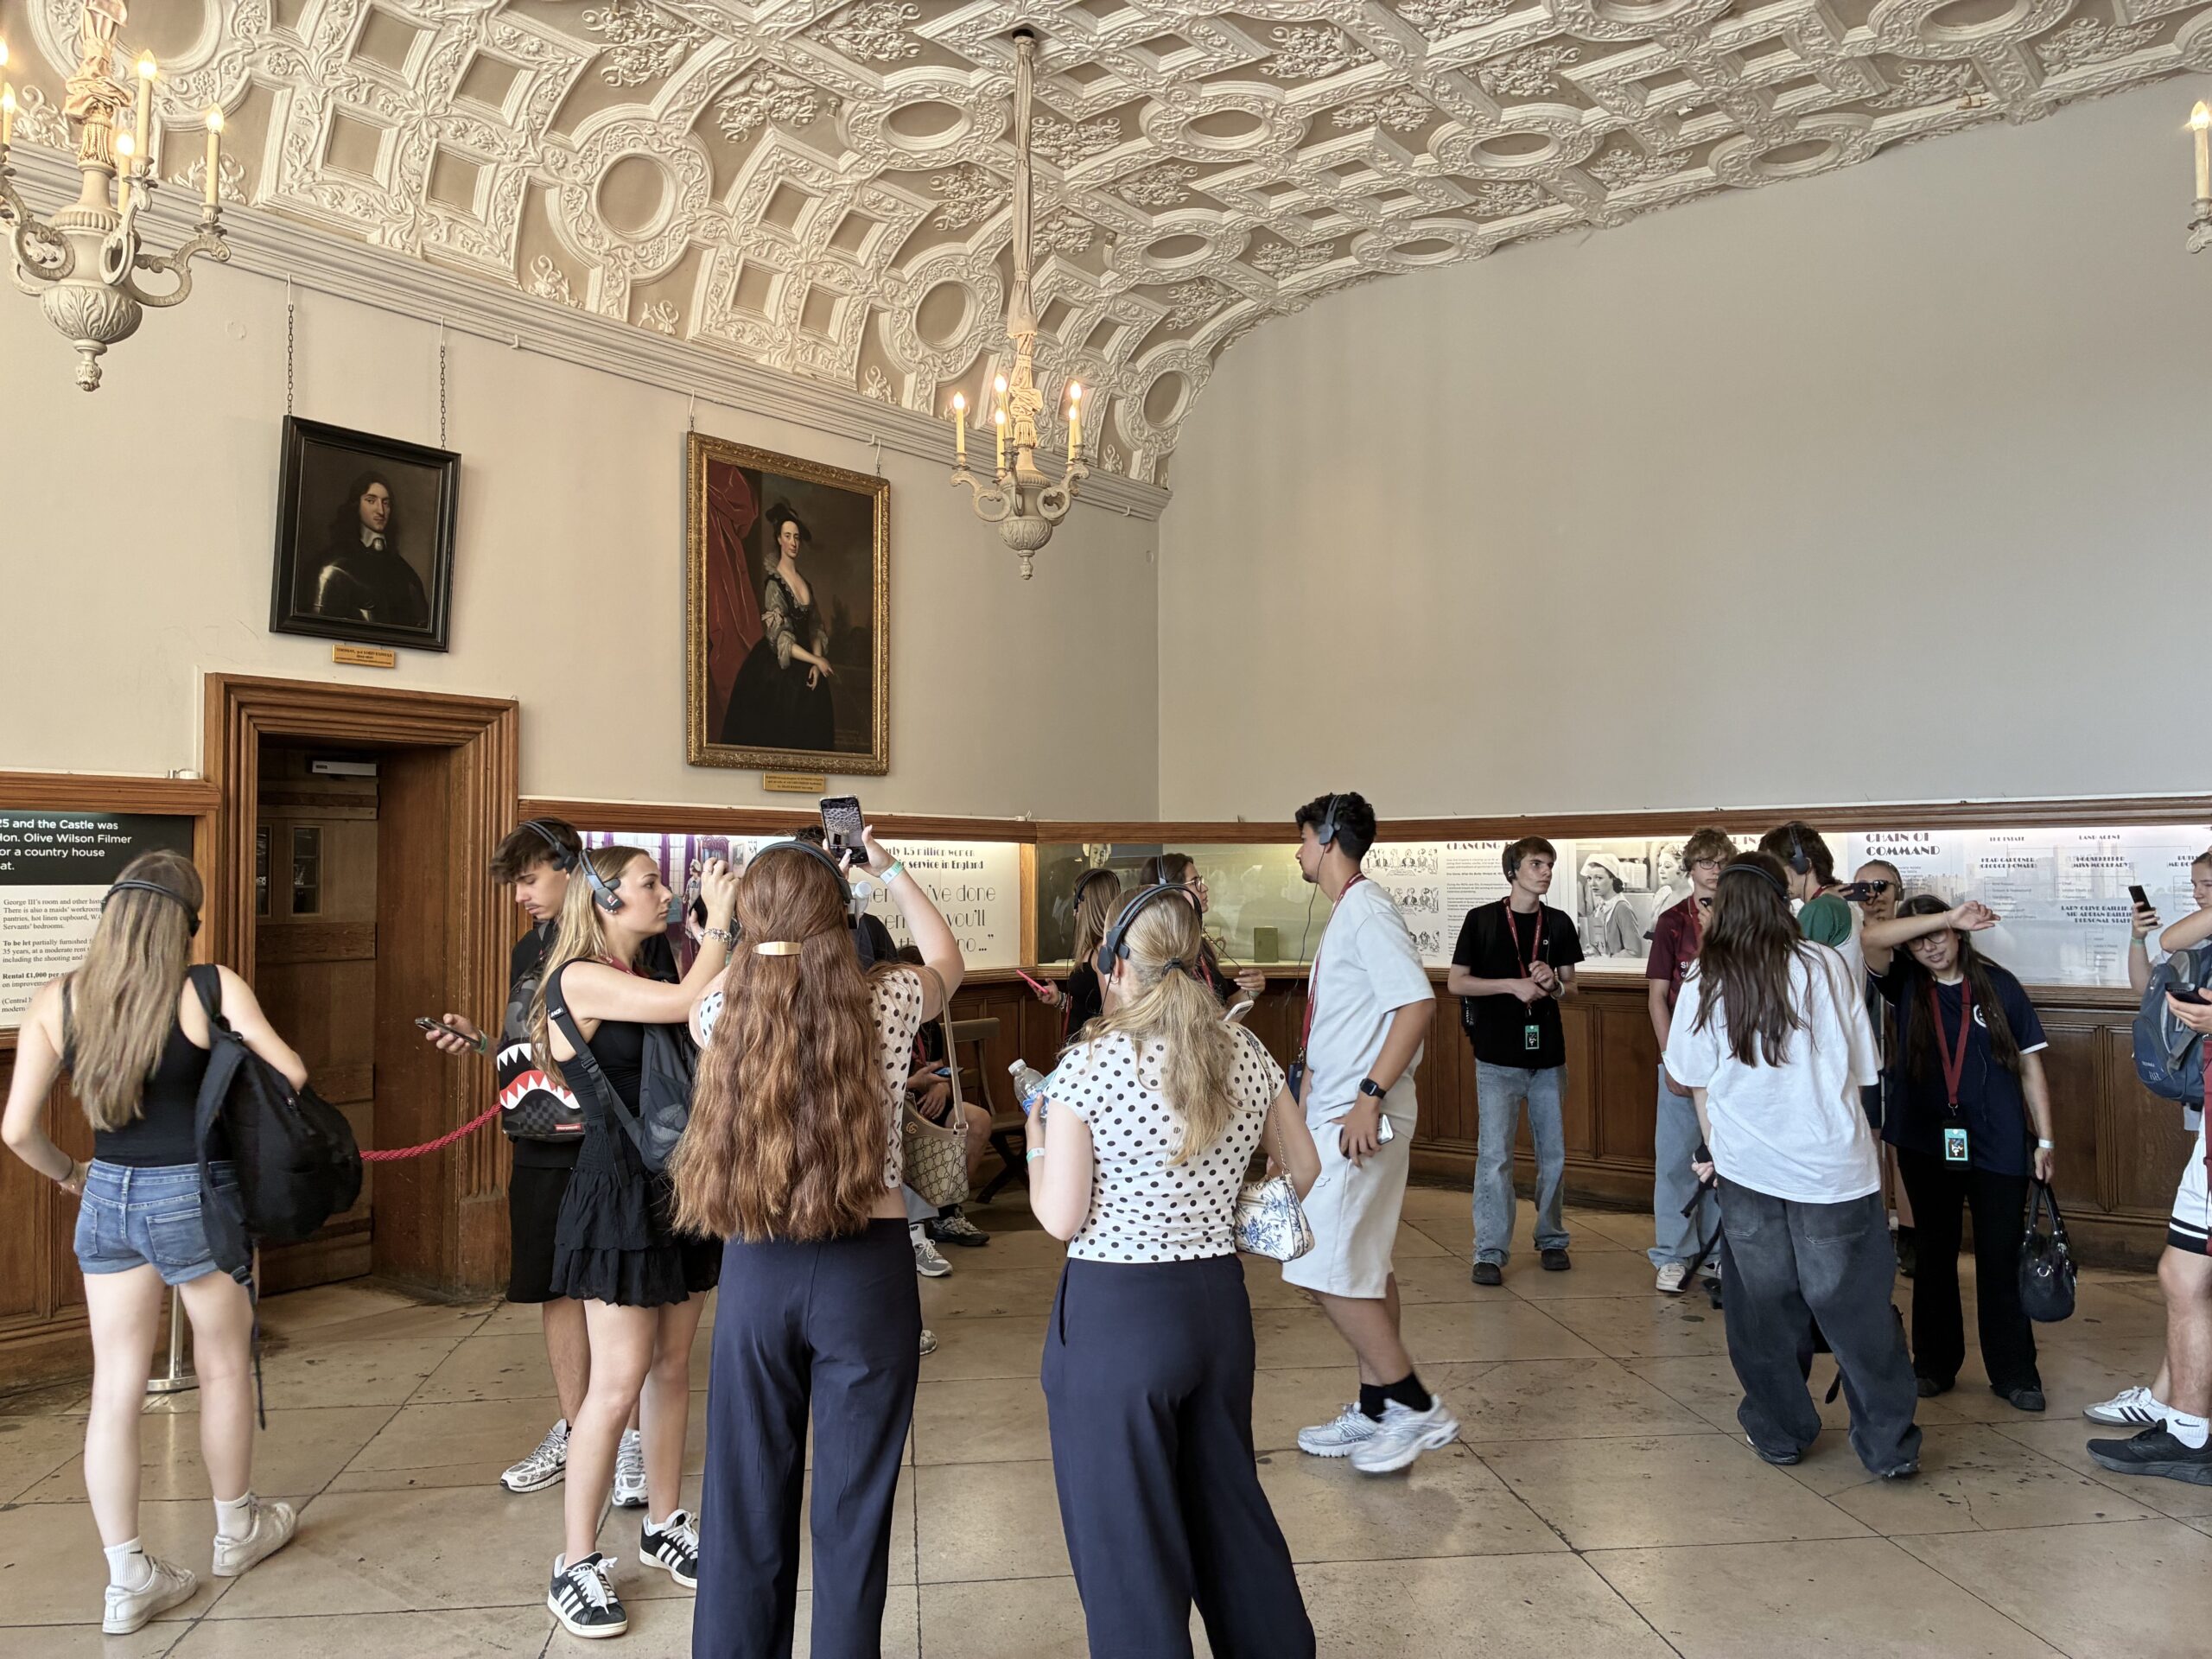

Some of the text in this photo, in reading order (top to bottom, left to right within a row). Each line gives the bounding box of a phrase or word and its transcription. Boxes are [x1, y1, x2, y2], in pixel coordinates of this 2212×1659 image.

[12, 819, 35, 829] and
[37, 820, 57, 830] the
[60, 820, 94, 830] Castle
[23, 833, 54, 843] Olive
[56, 834, 95, 844] Wilson
[98, 835, 132, 844] Filmer
[1866, 832, 1930, 842] CHAIN OF
[903, 847, 915, 855] 1.5
[1446, 842, 1501, 850] CHANGING
[1866, 845, 1941, 856] COMMAND
[24, 849, 69, 858] country
[72, 848, 105, 857] house
[908, 859, 939, 869] service
[941, 860, 950, 869] in
[951, 860, 984, 871] England
[956, 884, 996, 901] done
[946, 909, 985, 928] you'll
